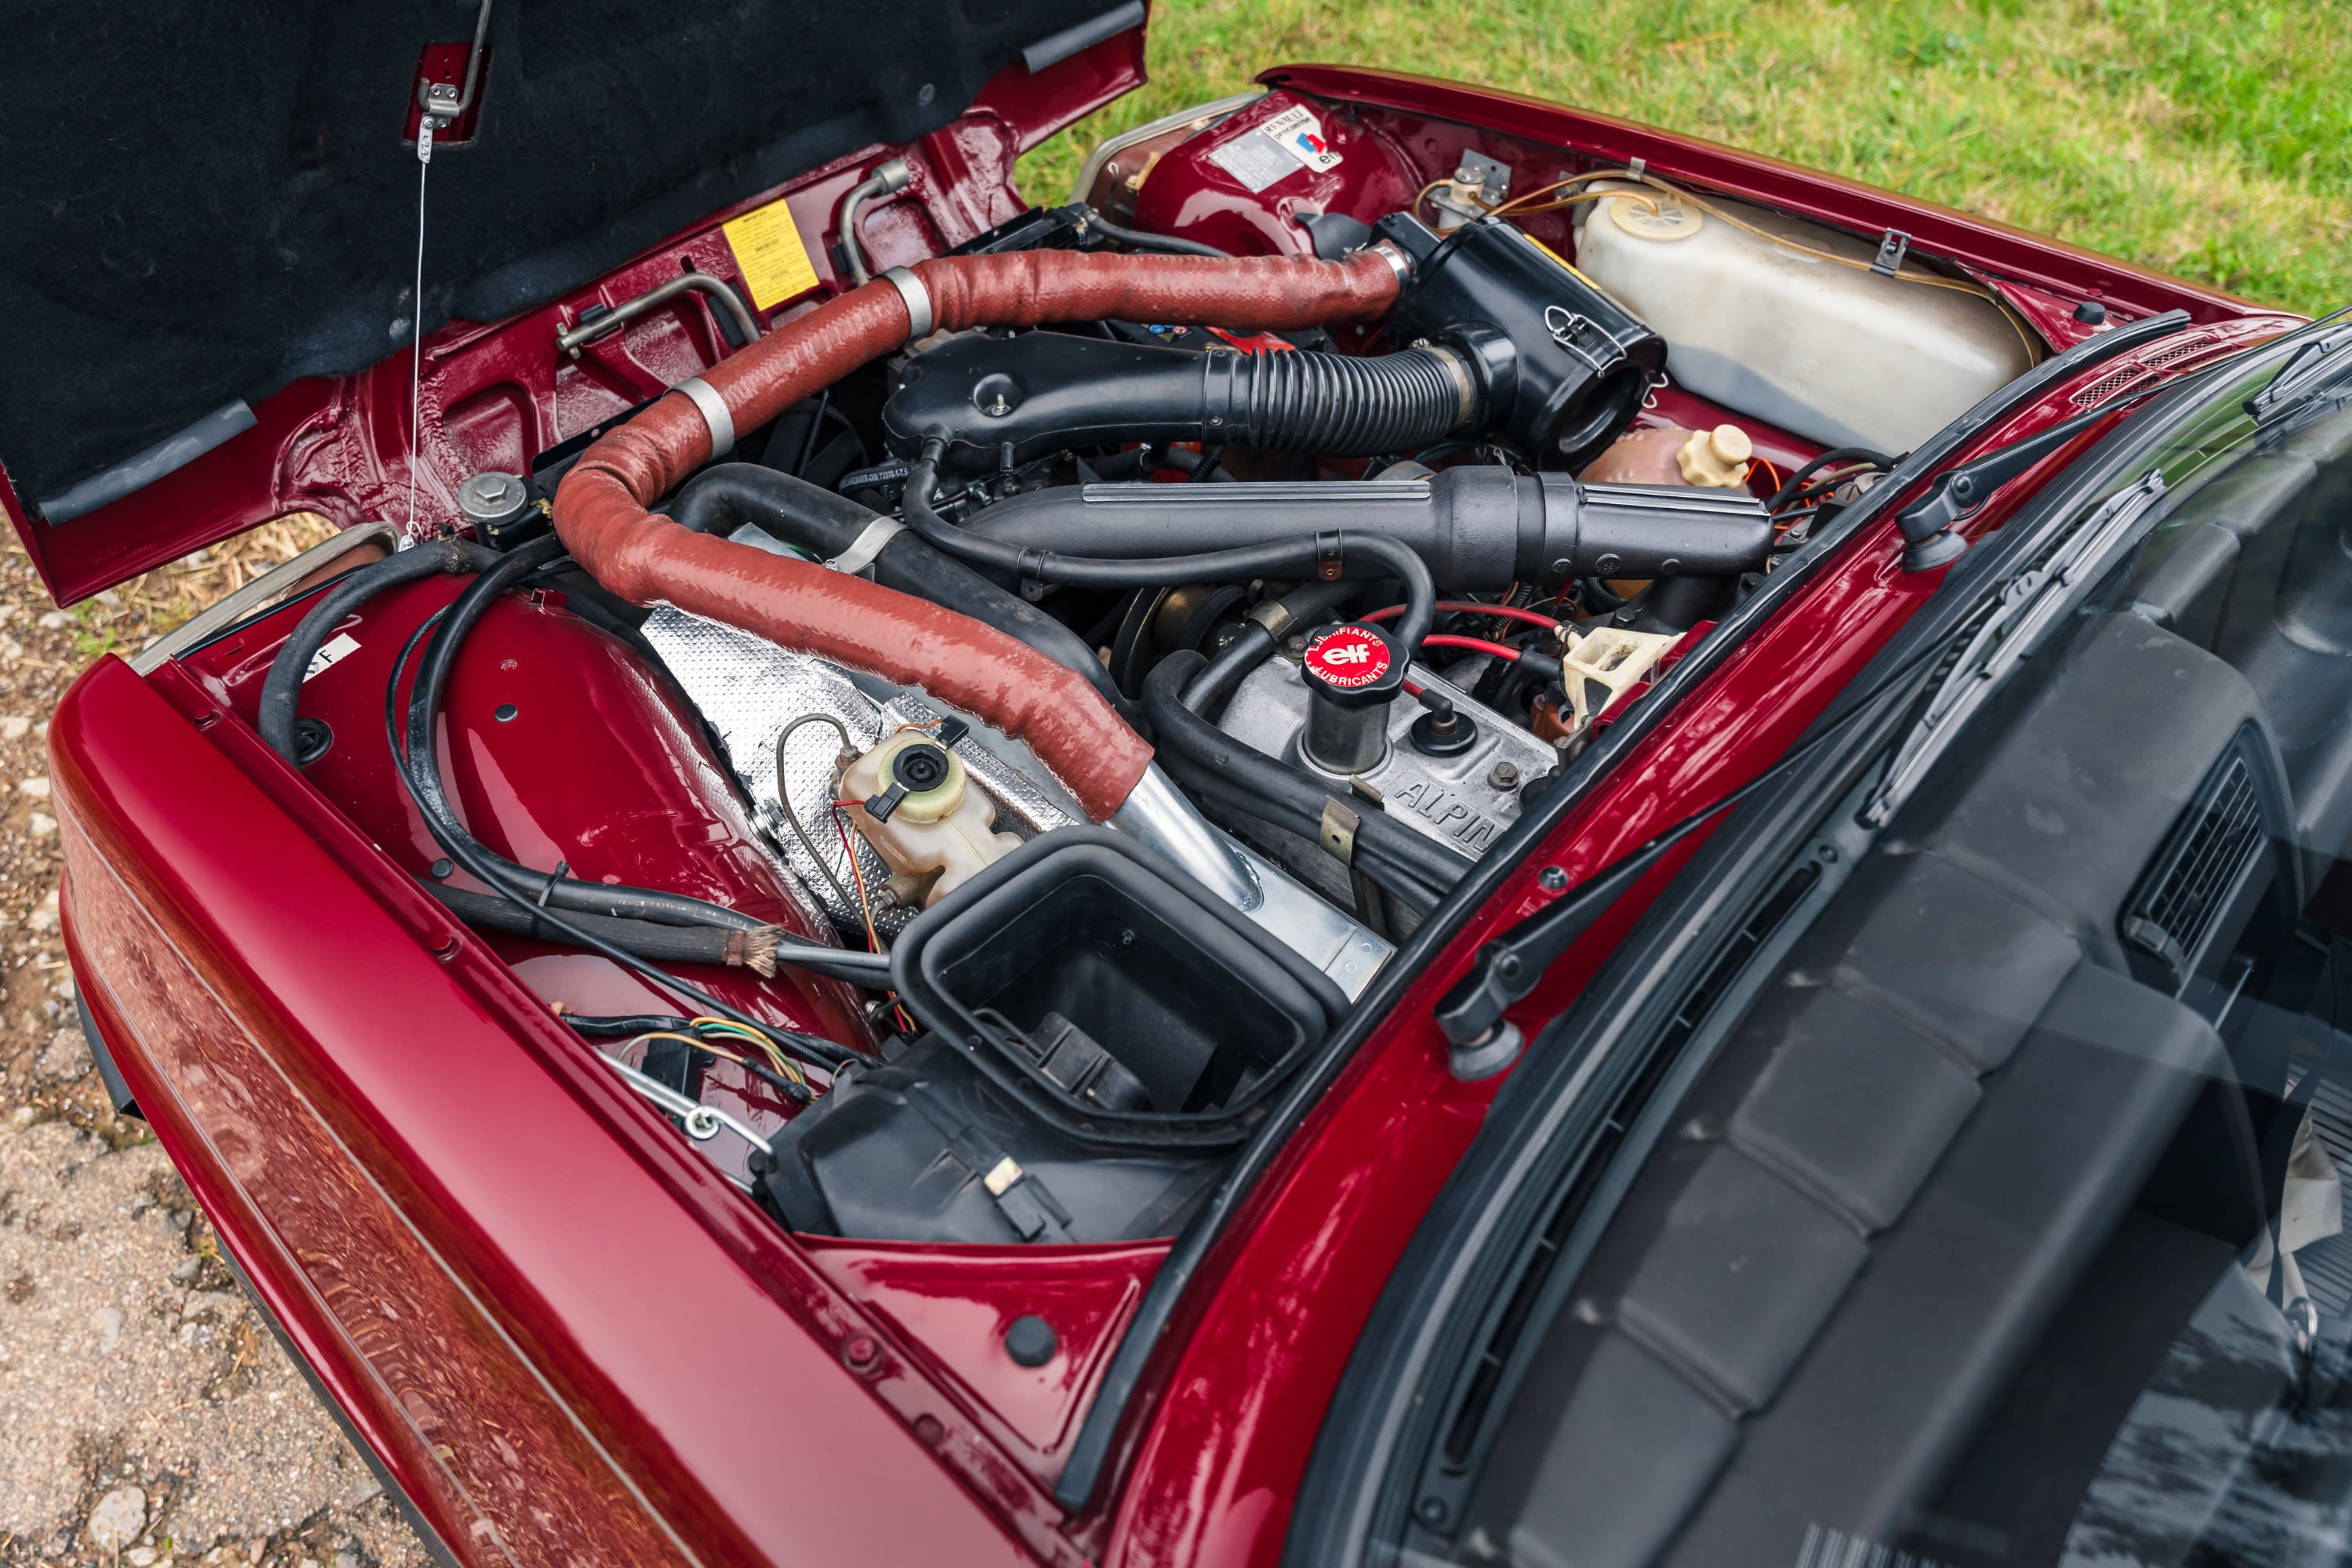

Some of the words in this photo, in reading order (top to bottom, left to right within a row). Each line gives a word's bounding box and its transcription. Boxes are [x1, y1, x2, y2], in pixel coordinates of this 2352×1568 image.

[318, 649, 332, 663] F
[1322, 644, 1371, 666] elf
[1312, 661, 1388, 686] LUBRICANTS
